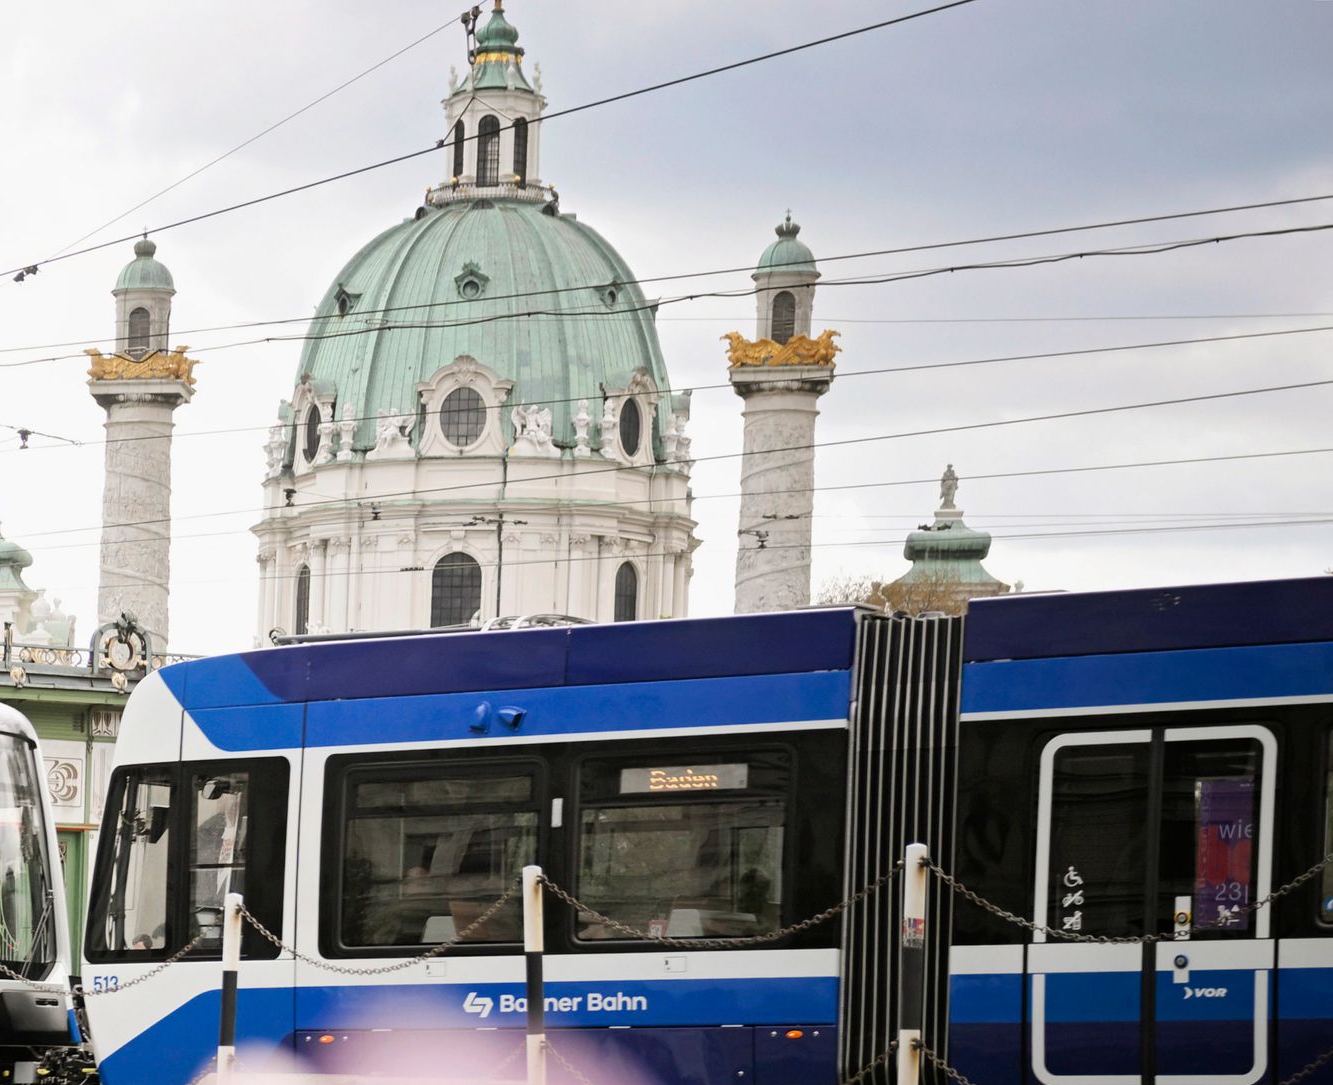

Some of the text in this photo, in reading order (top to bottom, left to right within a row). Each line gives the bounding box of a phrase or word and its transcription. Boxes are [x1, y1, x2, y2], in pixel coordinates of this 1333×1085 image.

[94, 976, 118, 993] 513
[1194, 987, 1227, 998] VOR
[499, 992, 647, 1012] Baner Bahn
